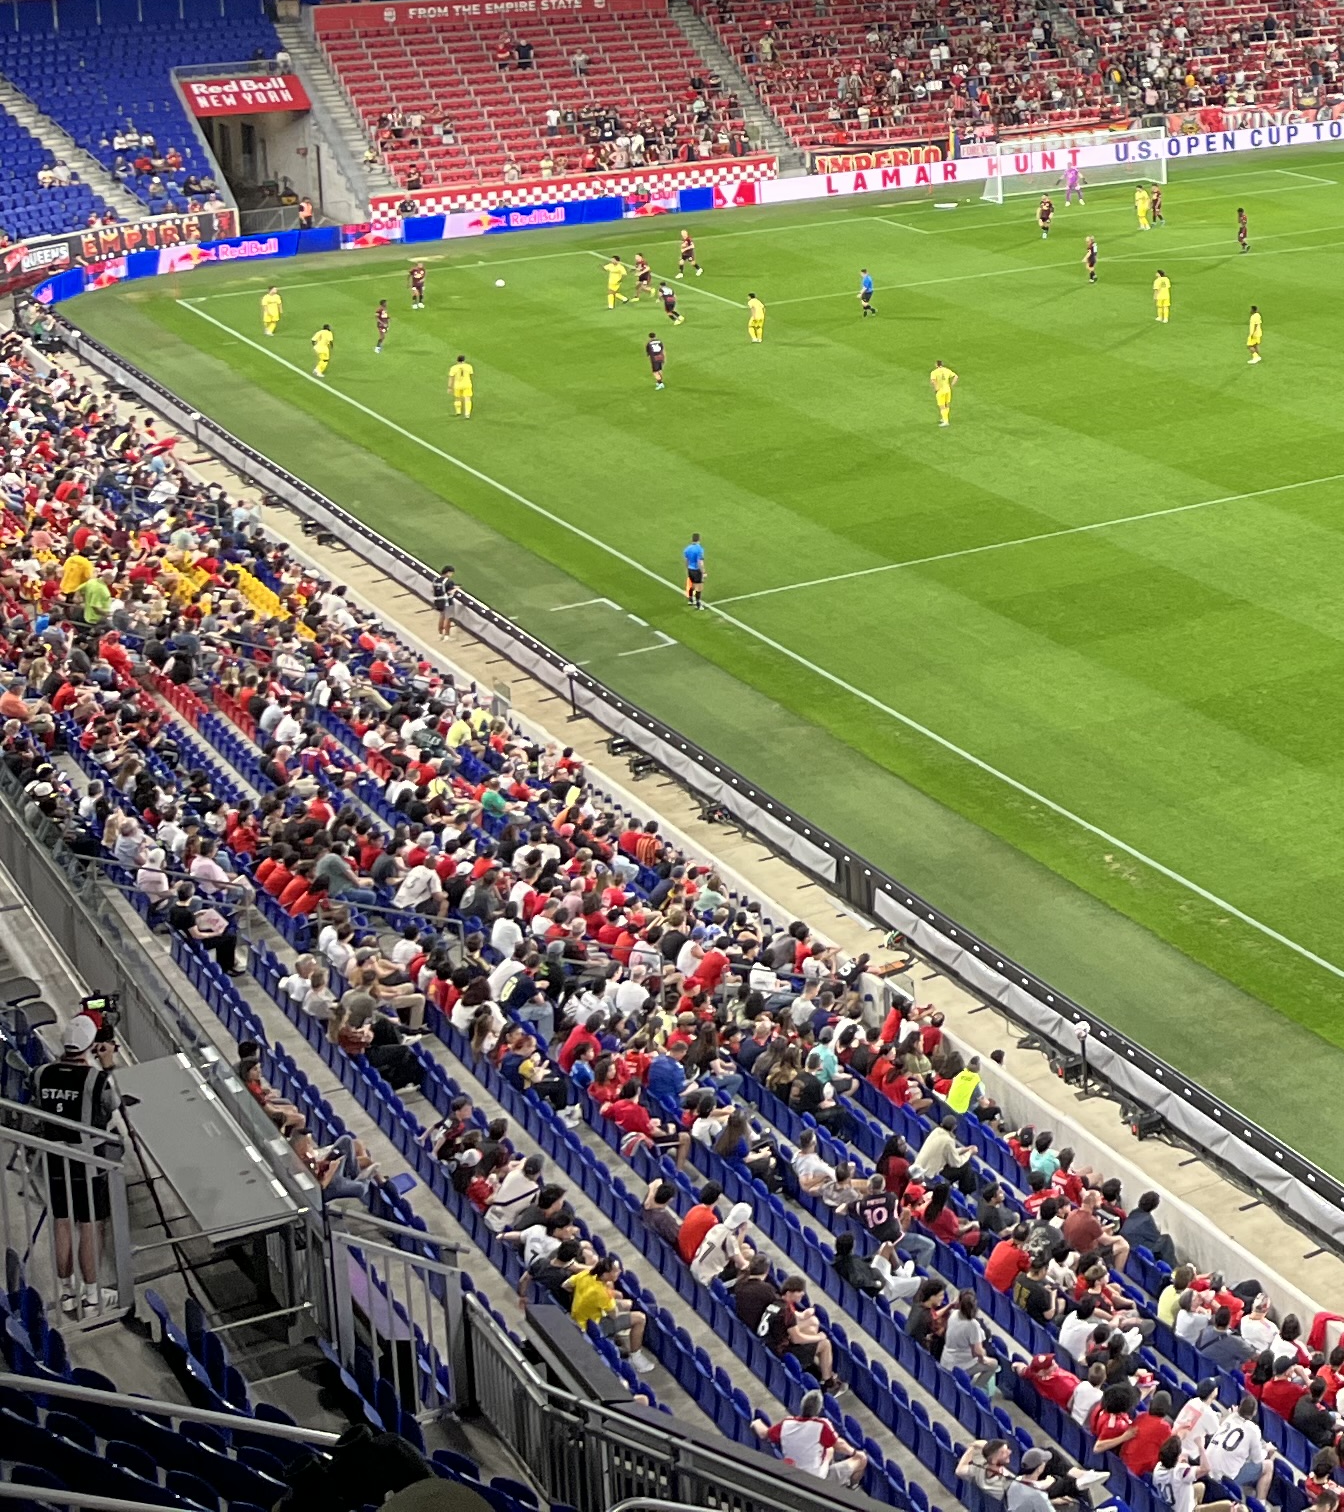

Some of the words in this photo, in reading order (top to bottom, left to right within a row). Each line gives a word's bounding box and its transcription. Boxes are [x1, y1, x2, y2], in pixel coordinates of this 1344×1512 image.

[408, 6, 449, 19] FROM
[453, 4, 481, 17] THE
[485, 1, 535, 14] EMPIRE
[190, 80, 239, 95] Red
[240, 77, 286, 91] Bull
[196, 94, 237, 108] NEW
[242, 89, 293, 105] YORK
[1115, 142, 1158, 162] U.S.
[1168, 131, 1235, 156] OPEN
[1251, 126, 1298, 147] CUP
[827, 162, 957, 194] LAMAR
[988, 149, 1080, 177] HUNT
[510, 211, 538, 227] Red
[539, 207, 565, 224] Bull
[22, 244, 69, 270] QUEENS
[219, 242, 249, 259] Red
[249, 238, 278, 256] Bull
[41, 1088, 79, 1101] STAFF
[864, 1207, 888, 1228] 10
